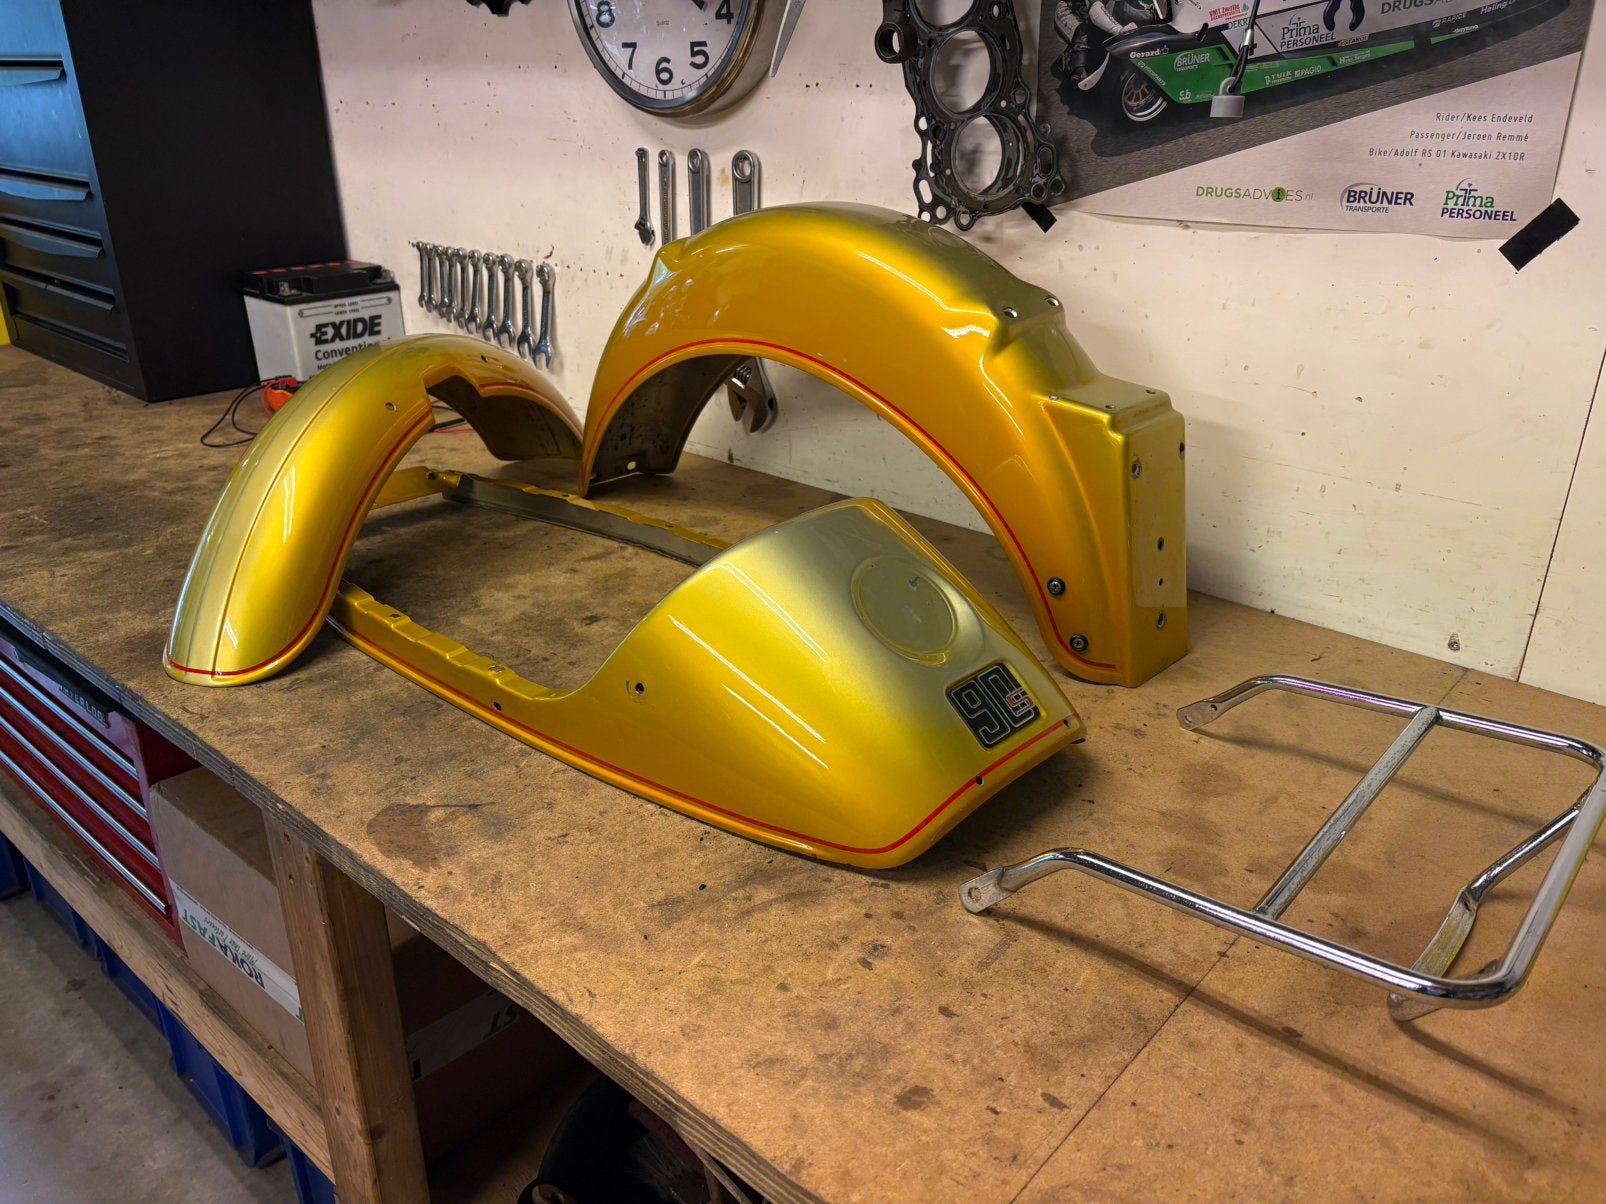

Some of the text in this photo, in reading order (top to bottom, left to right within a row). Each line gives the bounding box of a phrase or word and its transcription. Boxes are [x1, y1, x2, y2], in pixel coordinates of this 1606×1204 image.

[595, 0, 616, 28] 8
[715, 0, 734, 24] 4
[1281, 20, 1320, 40] Prima
[1280, 32, 1336, 50] PERSONEEL
[621, 41, 638, 70] 7
[689, 41, 709, 70] 5
[1130, 48, 1161, 59] Gerard
[1176, 52, 1211, 67] BRÜNER
[654, 56, 674, 86] 6
[1435, 112, 1534, 123] Rider/Kees Endeveld
[1409, 130, 1529, 142] Passenger/Jeroen Remmé
[1369, 147, 1418, 158] Bike/Adolf
[1421, 149, 1433, 158] RS
[1450, 150, 1492, 160] Kawasaki
[1495, 151, 1526, 161] ZX10R
[1345, 187, 1415, 207] BRÜNER
[1443, 187, 1496, 209] Prima
[1345, 205, 1390, 214] TRANSPORTE
[1440, 207, 1518, 222] PERSONEEL
[310, 314, 382, 346] EXIDE
[314, 337, 392, 361] Conventi
[182, 908, 266, 990] ROKAFAST
